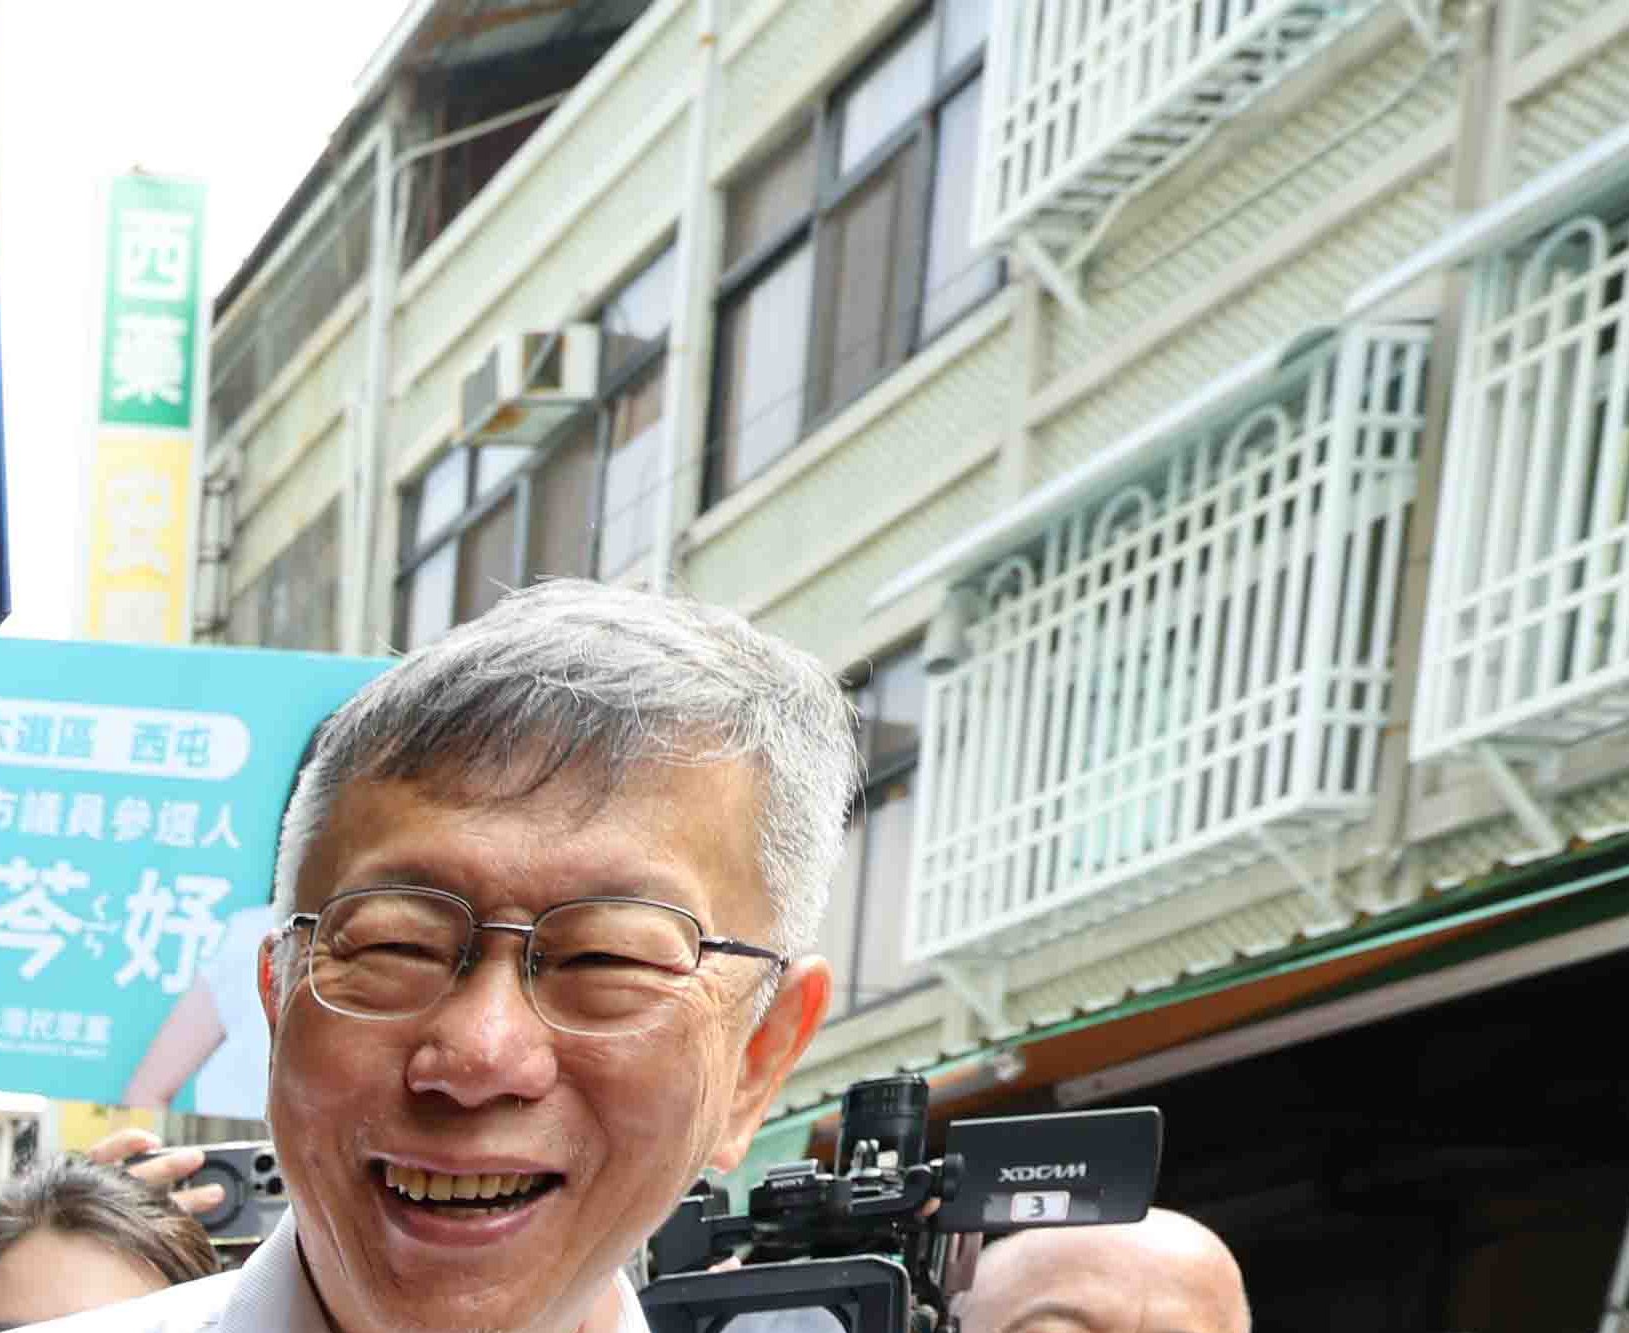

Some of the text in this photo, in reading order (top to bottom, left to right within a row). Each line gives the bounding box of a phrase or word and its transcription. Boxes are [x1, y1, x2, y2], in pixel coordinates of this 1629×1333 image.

[130, 723, 212, 768] 西屯
[999, 1160, 1086, 1183] XDCAM
[1028, 1196, 1046, 1218] 3
